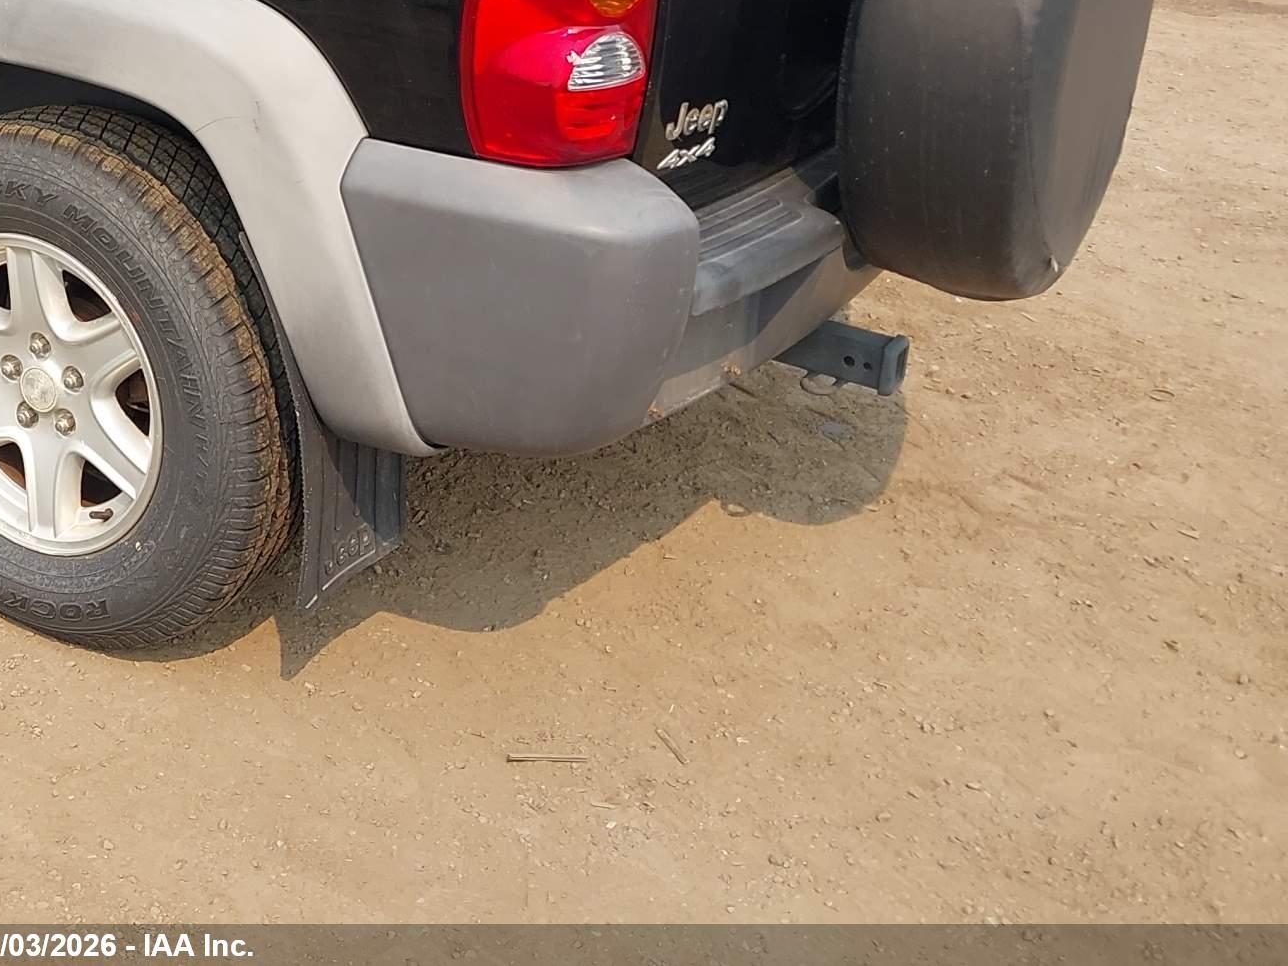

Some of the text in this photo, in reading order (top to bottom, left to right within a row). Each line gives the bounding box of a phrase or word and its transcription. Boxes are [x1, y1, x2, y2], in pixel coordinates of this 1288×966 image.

[665, 98, 729, 141] Jeep
[62, 202, 207, 430] MOUNTAIN
[324, 523, 370, 575] Jeep
